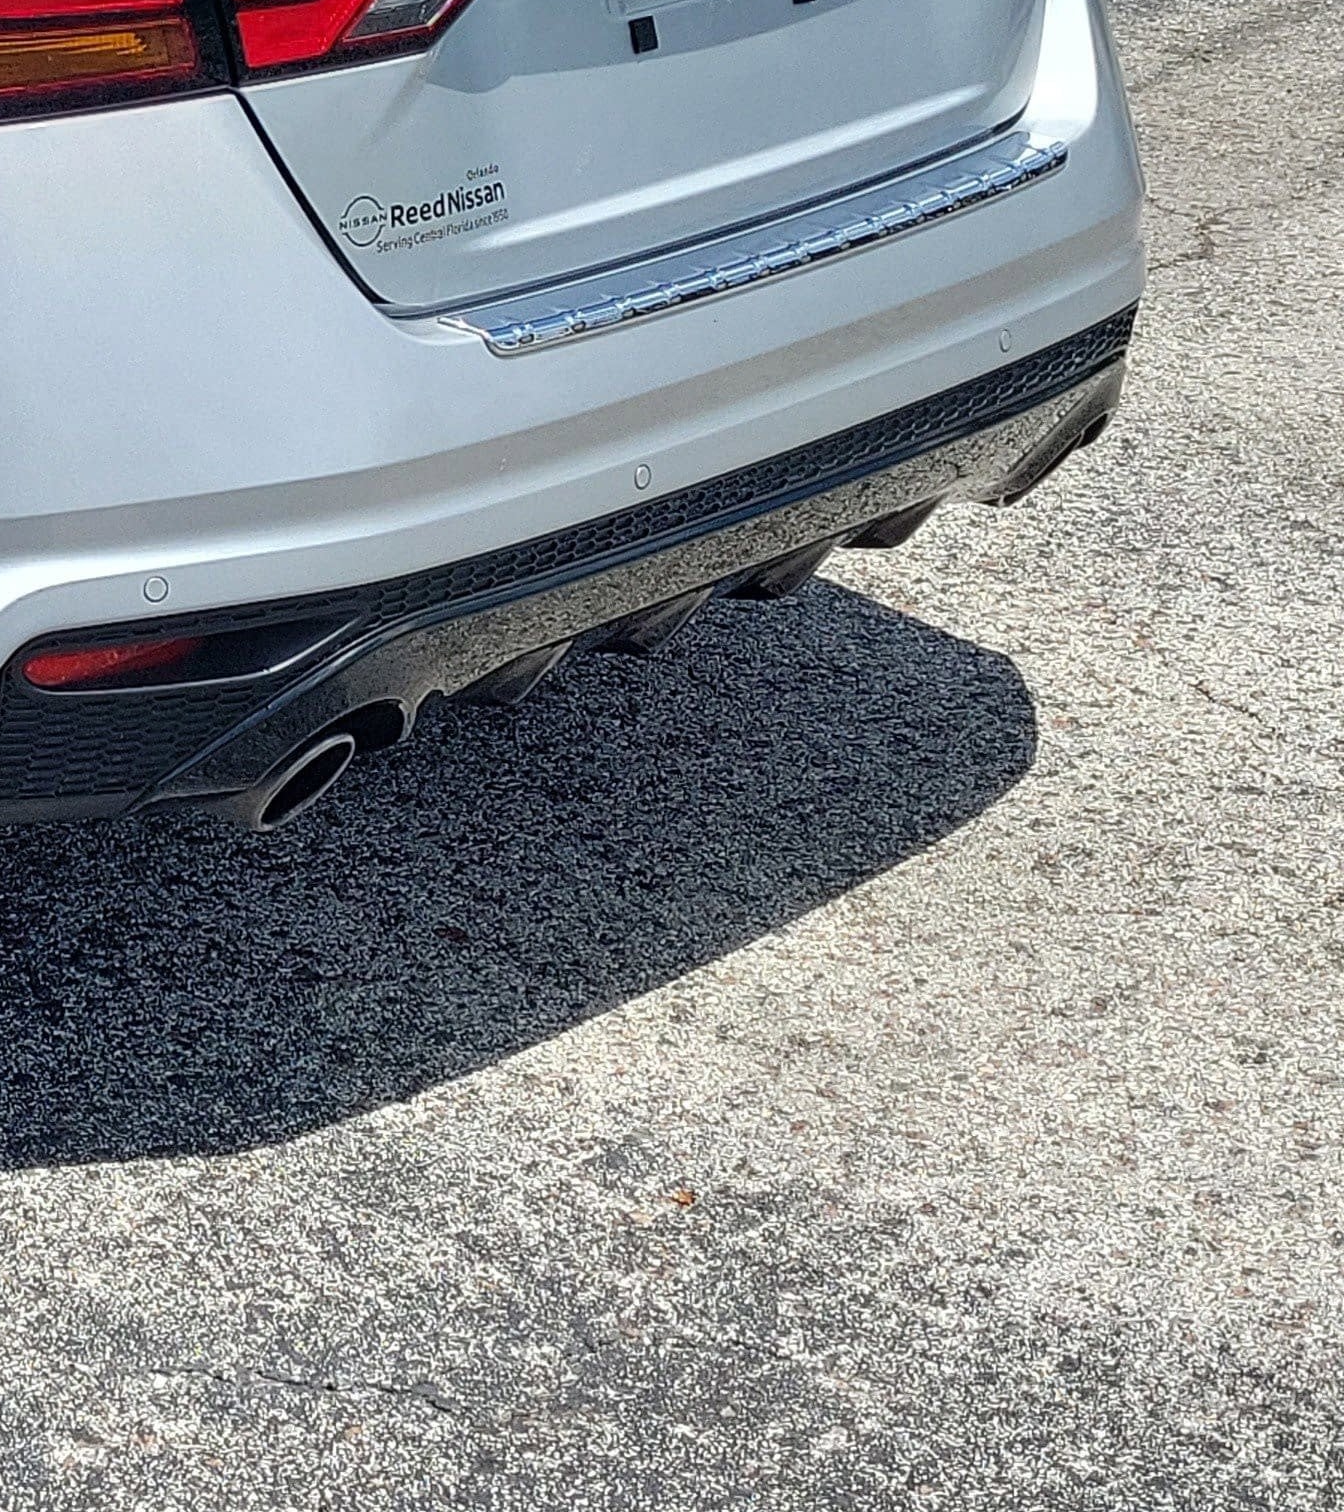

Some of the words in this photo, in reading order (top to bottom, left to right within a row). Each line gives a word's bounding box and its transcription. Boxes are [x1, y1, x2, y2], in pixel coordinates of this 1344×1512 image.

[391, 193, 444, 228] Reed
[447, 181, 505, 215] Nissan
[339, 211, 387, 230] NISSAN
[377, 236, 414, 253] Serving
